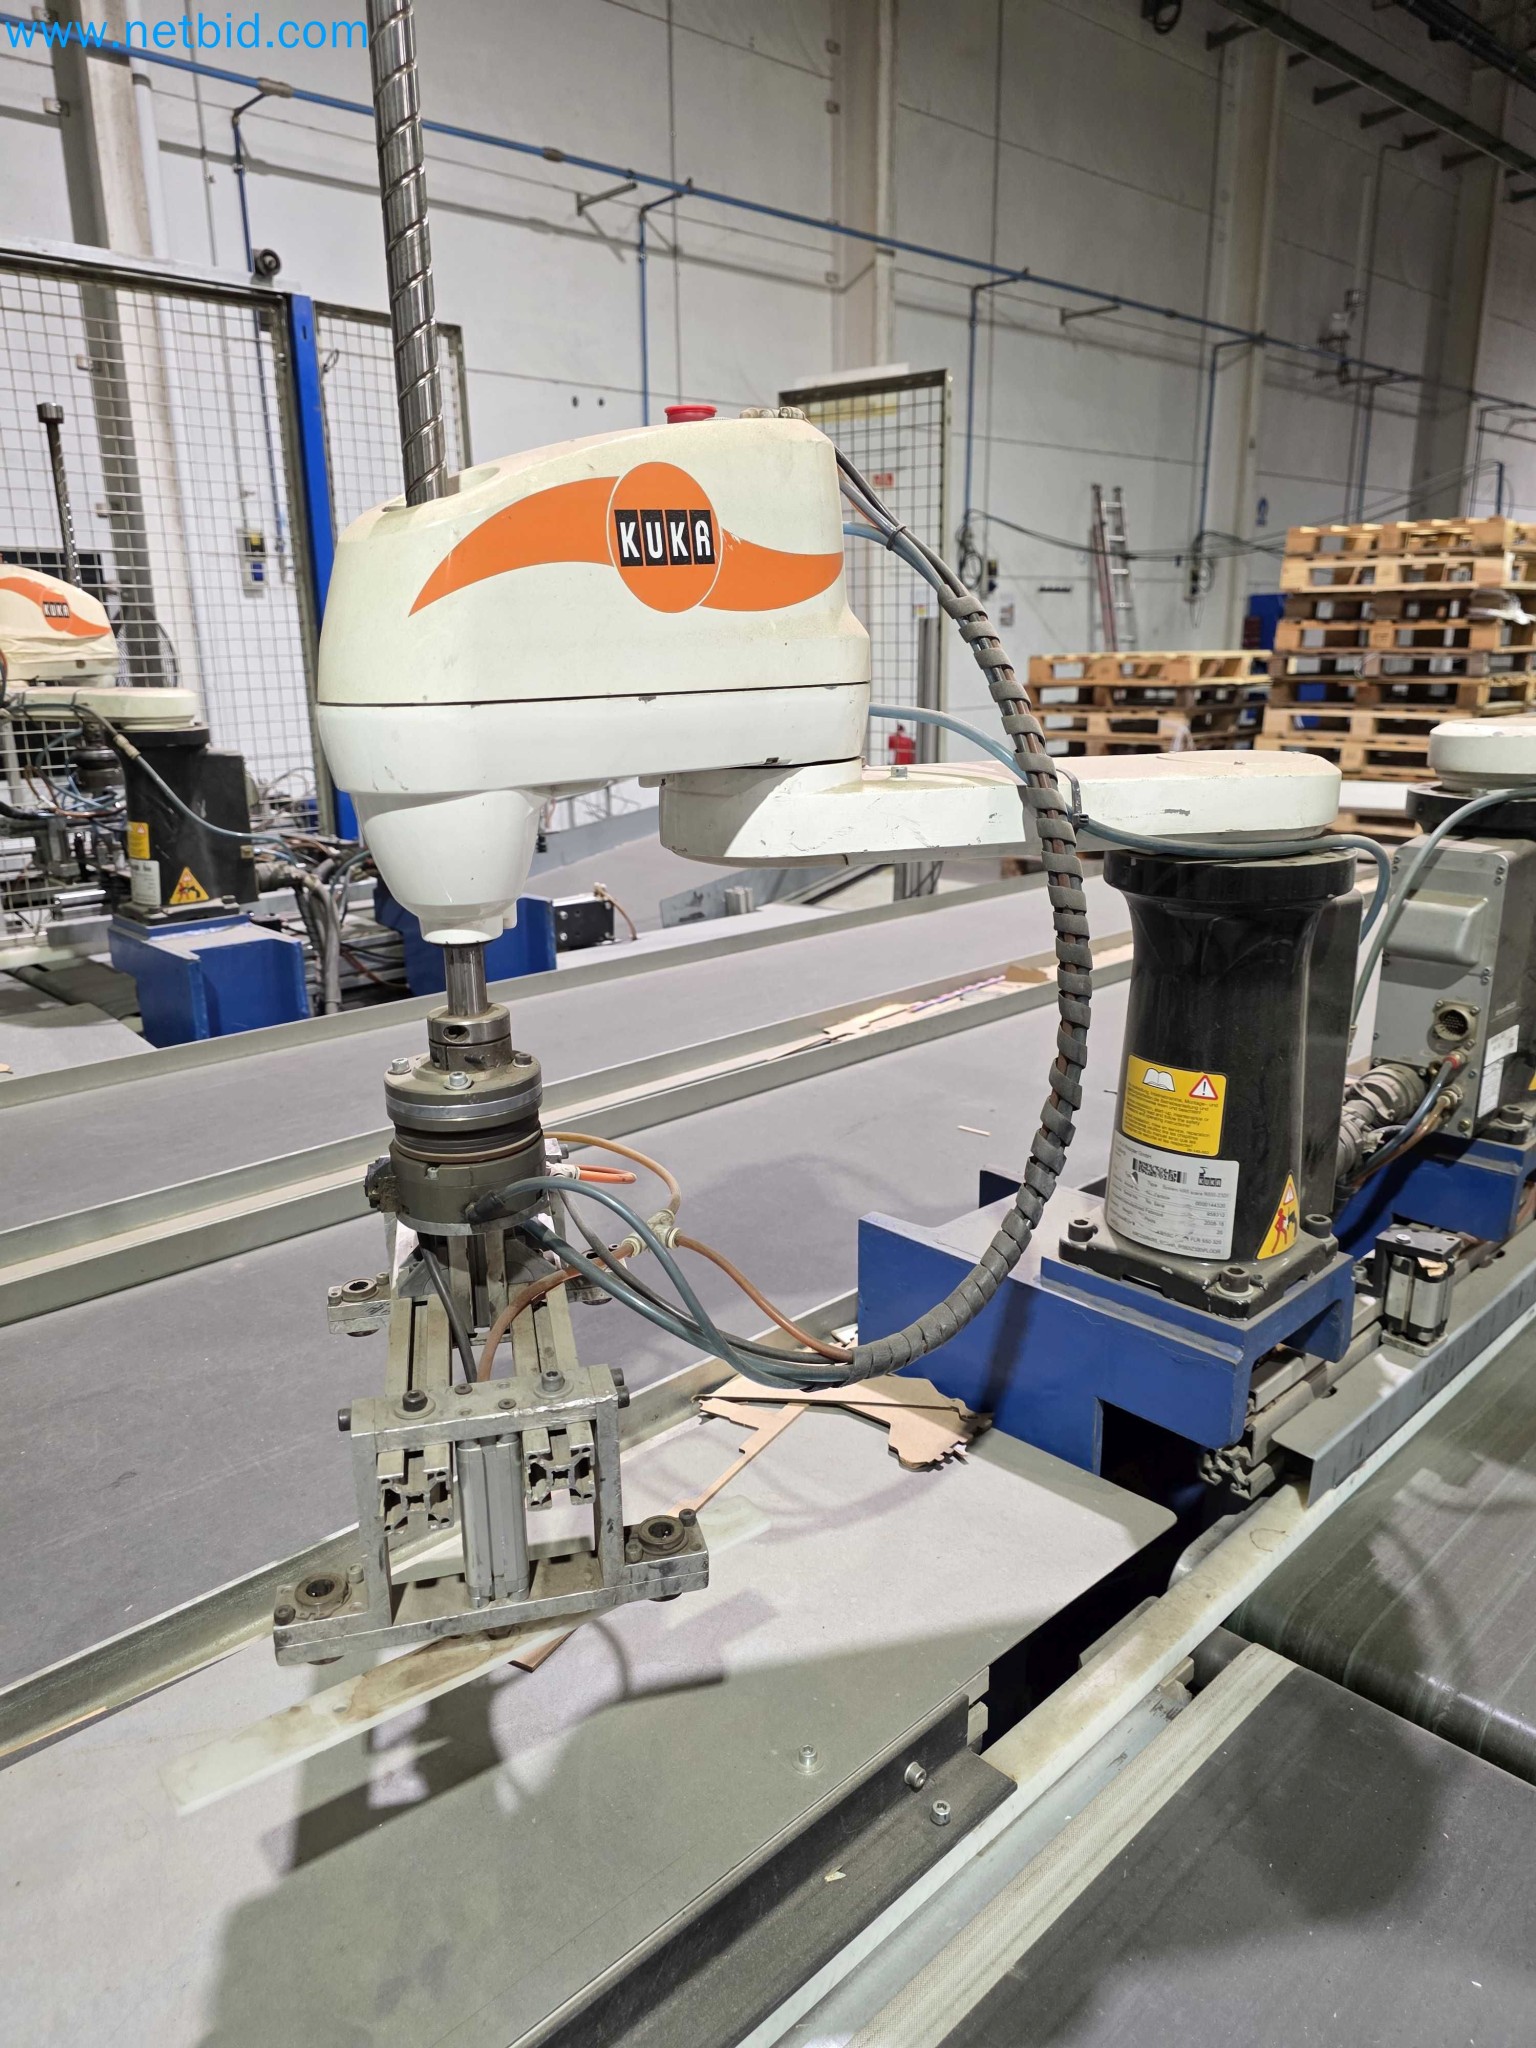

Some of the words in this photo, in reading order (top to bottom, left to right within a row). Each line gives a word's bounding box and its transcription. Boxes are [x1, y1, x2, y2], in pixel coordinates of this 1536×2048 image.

[618, 519, 712, 560] KUKA
[44, 602, 69, 617] KUKA
[1198, 1177, 1221, 1187] KUKA
